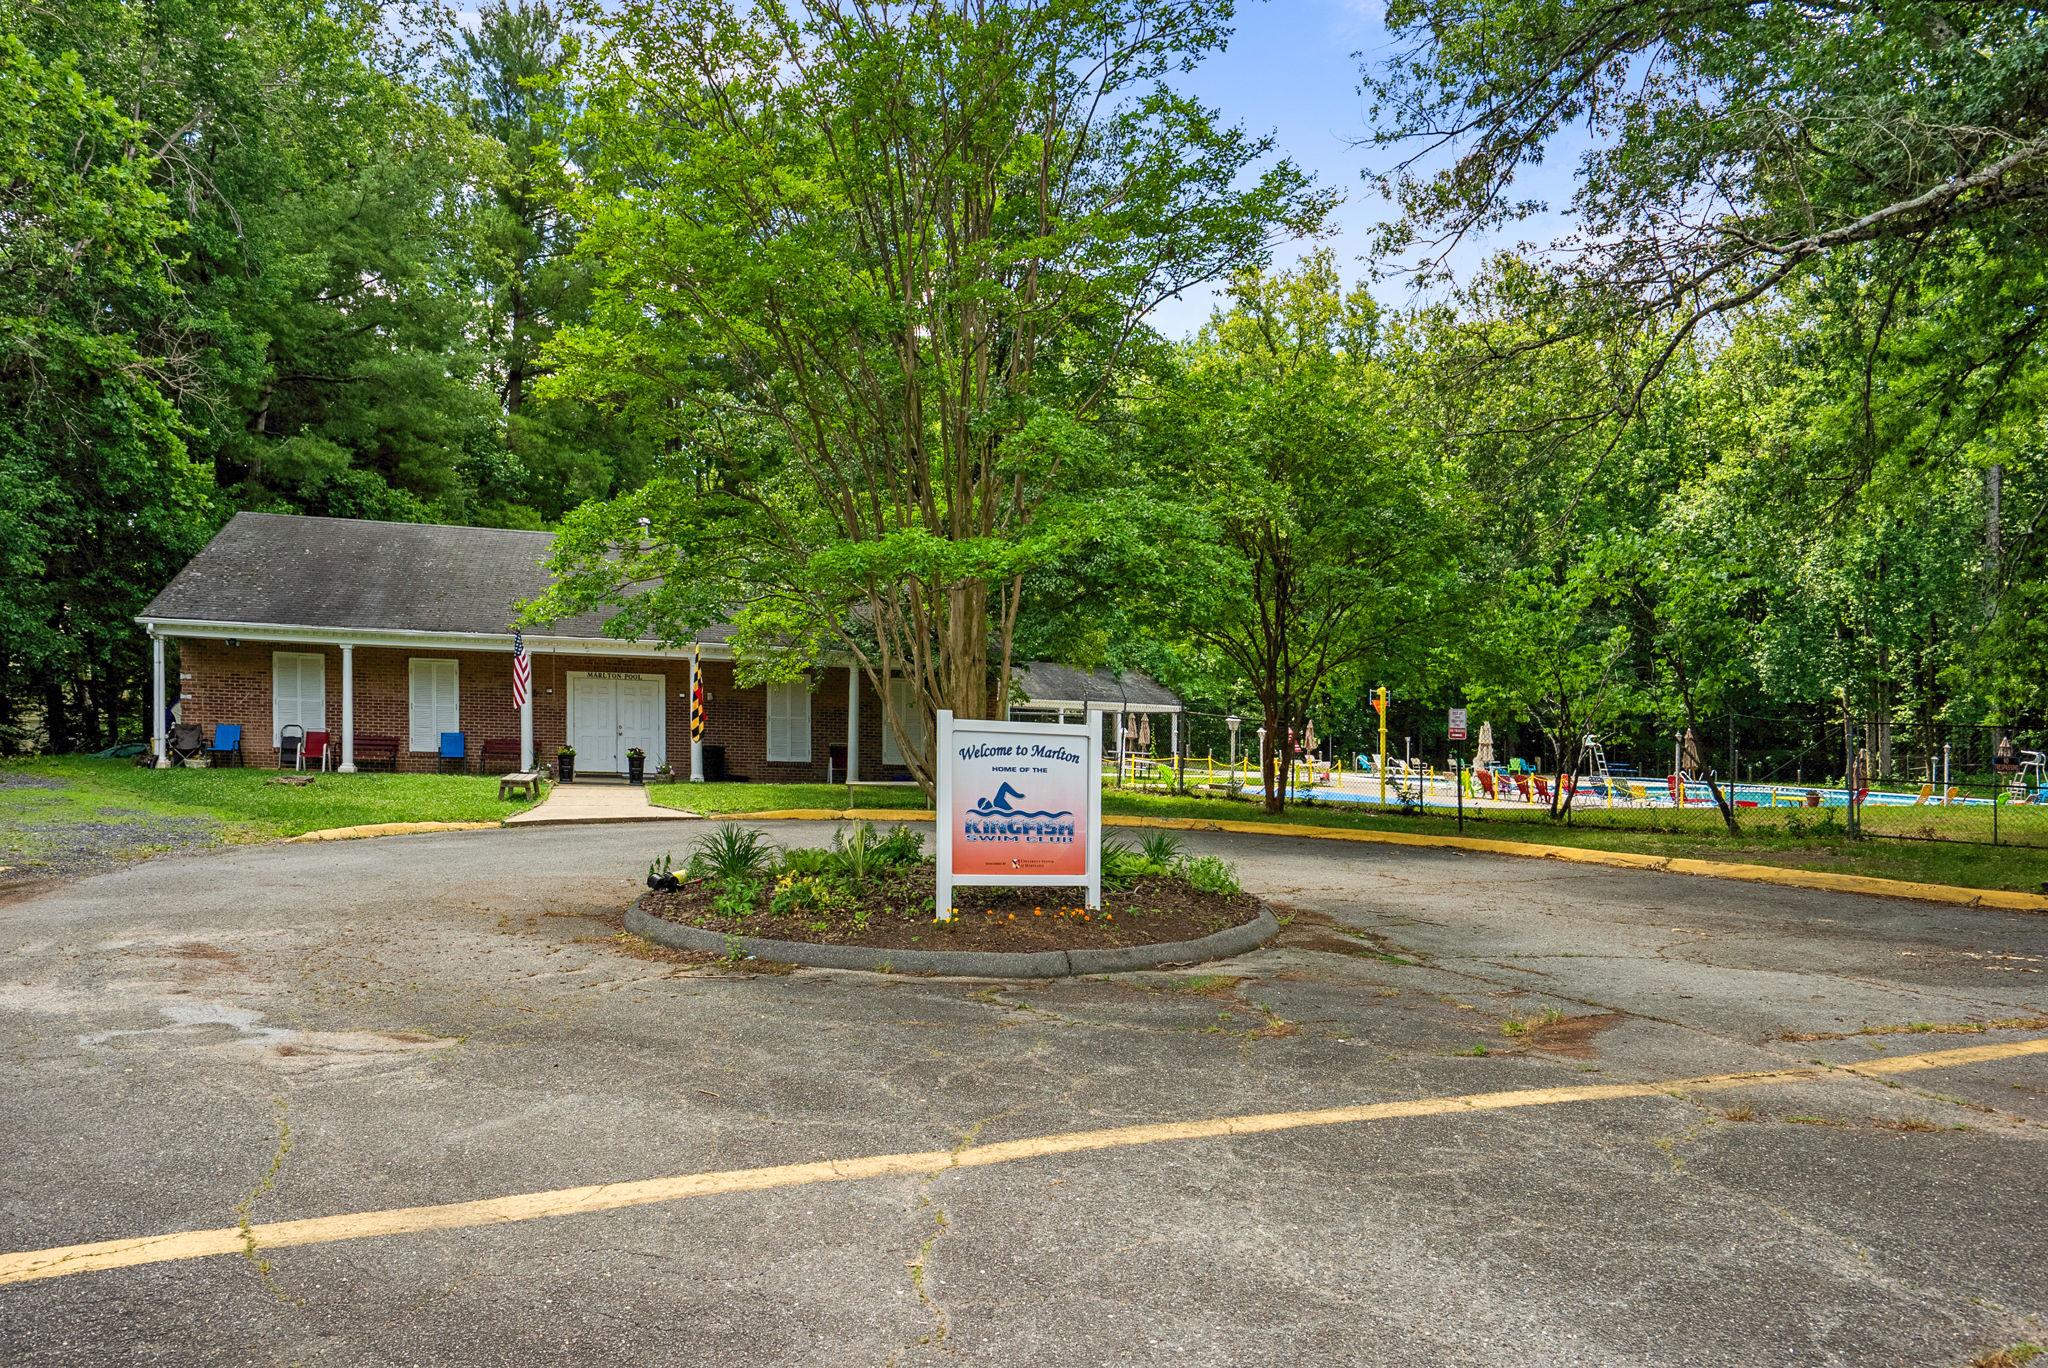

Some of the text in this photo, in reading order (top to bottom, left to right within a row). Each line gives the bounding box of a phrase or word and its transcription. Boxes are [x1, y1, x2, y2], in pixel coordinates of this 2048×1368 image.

[587, 672, 621, 680] MARLTON
[959, 743, 1080, 764] Welcome to Marlton
[965, 820, 1074, 835] KINGFISH
[1026, 836, 1073, 844] CLUB
